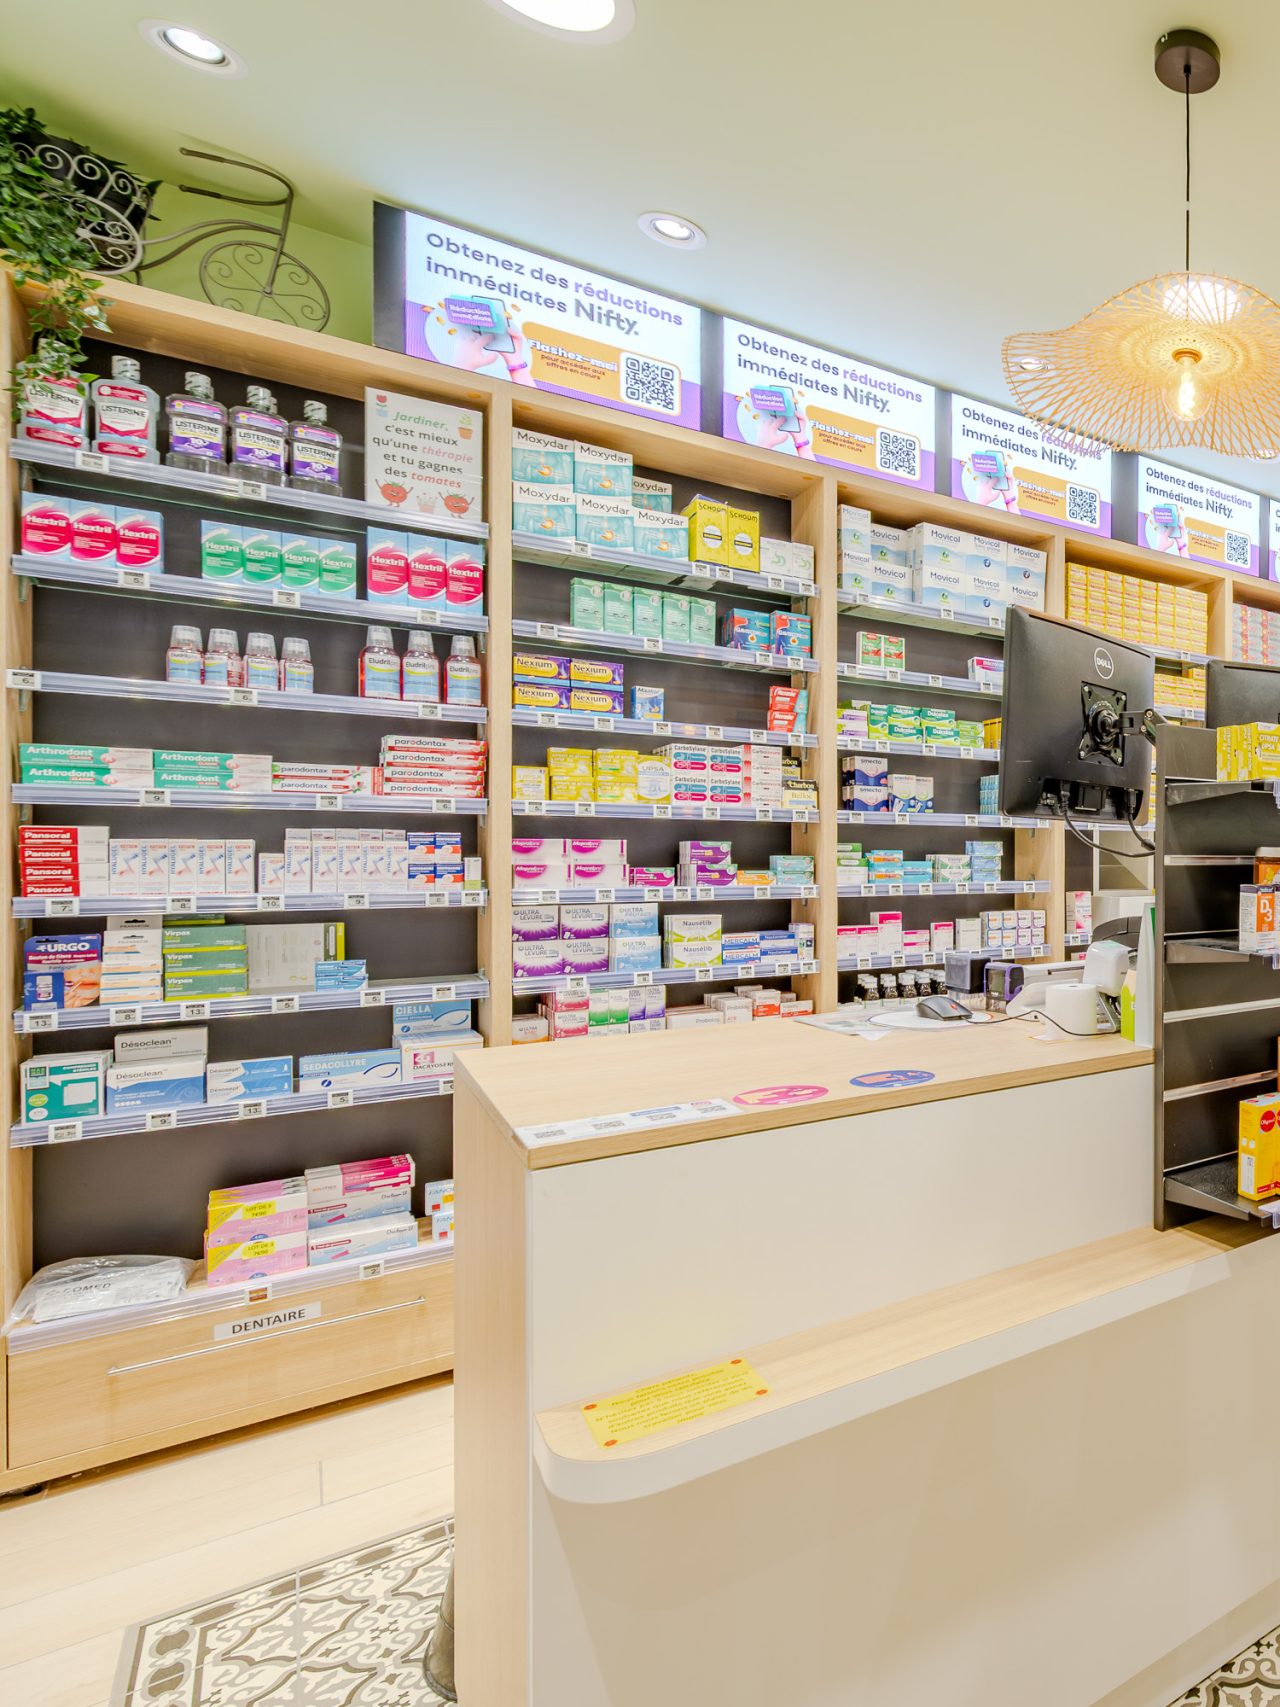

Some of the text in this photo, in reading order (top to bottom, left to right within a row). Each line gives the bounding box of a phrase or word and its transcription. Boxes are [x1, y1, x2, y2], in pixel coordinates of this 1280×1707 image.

[426, 232, 683, 327] Obtenez des réductions
[426, 257, 640, 337] immédiates Nifty.
[529, 337, 619, 373] Flashez-moi
[738, 333, 922, 404] Obtenez des réductions
[737, 354, 891, 413] immédiates Nifty.
[100, 404, 147, 418] LISTERINE
[175, 420, 219, 434] LISTERINE
[393, 412, 448, 431] Jardiner,
[962, 407, 1015, 433] Obtenez
[1017, 427, 1039, 440] des
[239, 431, 281, 446] LISTERINE
[385, 425, 458, 446] c'est mieux
[516, 431, 569, 452] Moxydar
[296, 446, 337, 459] LISTERINE
[372, 437, 474, 463] qu'une thérapie
[962, 425, 1078, 471] immédiates Nifty.
[580, 445, 629, 465] Moxydar
[384, 453, 463, 474] et tu gagnes
[384, 467, 462, 488] des tomates
[1146, 467, 1252, 509] Obtenez des réductions
[519, 486, 571, 504] Moxydar
[1146, 482, 1234, 519] immédiates Nifty.
[581, 498, 630, 516] Moxydar
[25, 515, 67, 528] Hextril
[638, 510, 684, 527] Moxydar
[73, 521, 114, 534] Hextril
[119, 528, 157, 540] Hextril
[931, 529, 961, 543] Movicol
[205, 541, 240, 553] Hextril
[974, 536, 1000, 548] Movicol
[245, 547, 280, 559] Hextril
[284, 552, 317, 563] Hextril
[843, 552, 870, 563] Movicol
[1014, 546, 1040, 559] Movicol
[322, 557, 354, 569] Hextril
[371, 555, 405, 567] Hextril
[410, 561, 444, 572] Hextril
[448, 567, 480, 578] Hextril
[874, 566, 906, 579] Movicol
[930, 572, 959, 585] Movicol
[973, 577, 1000, 588] Movicol
[1012, 586, 1039, 598] Movicol
[516, 658, 553, 669] Nexium
[573, 664, 607, 674] Nexium
[1096, 657, 1111, 669] DELL
[517, 688, 554, 699] Nexium
[573, 693, 607, 703] Nexium
[394, 738, 447, 748] parodontax
[26, 745, 94, 757] Arthrodont
[160, 752, 220, 762] Arthrodont
[392, 754, 446, 763] parodontax
[29, 768, 96, 778] Arthrodont
[160, 773, 220, 782] Arthrodont
[391, 769, 444, 778] parodontax
[280, 782, 328, 790] parodontax
[390, 785, 444, 793] parodontax
[24, 831, 71, 839] Pansoral
[24, 850, 71, 858] Pansoral
[25, 867, 72, 876] Pansoral
[27, 886, 73, 894] Pansoral
[724, 937, 758, 945] MERCALM
[47, 943, 90, 952] URGO
[395, 1007, 431, 1015] CIELLA
[121, 1038, 172, 1049] Désoclean
[303, 1058, 367, 1072] SEDACOLLYRE
[116, 1071, 163, 1080] Désoclean
[232, 1308, 307, 1335] DENTAIRE
